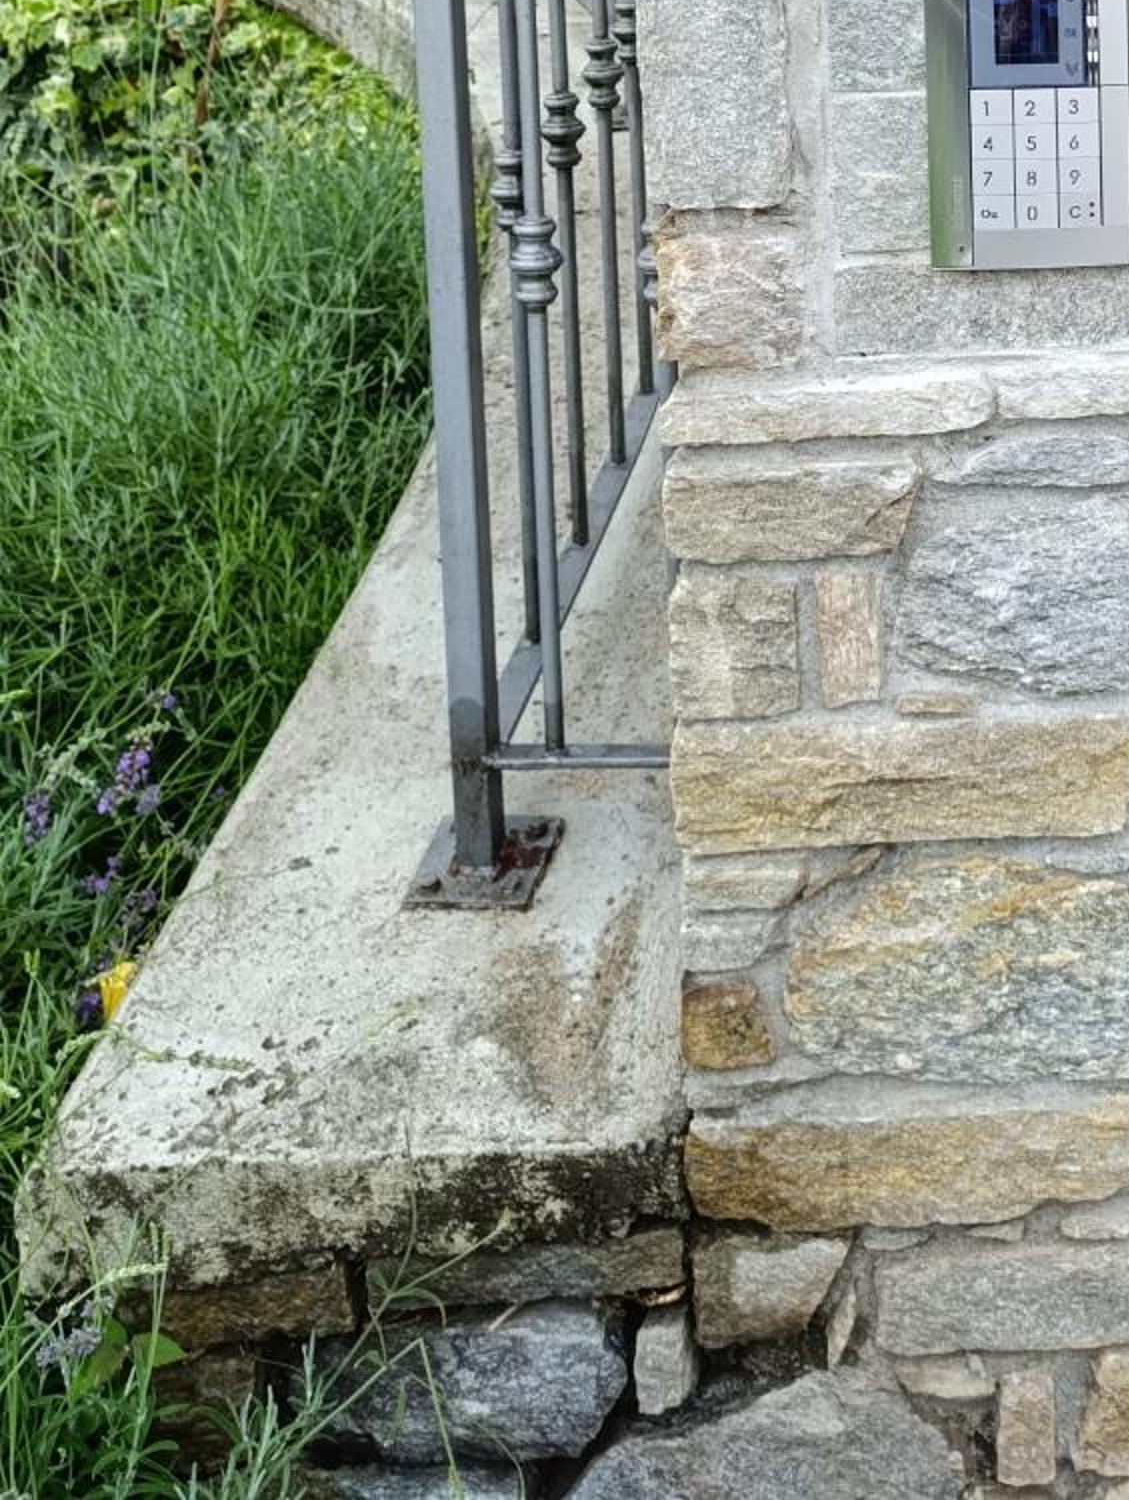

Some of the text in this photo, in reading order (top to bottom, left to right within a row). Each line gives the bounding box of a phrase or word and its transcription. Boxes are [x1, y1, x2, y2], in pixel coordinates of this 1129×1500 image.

[983, 100, 1079, 116] 1 2 3
[983, 135, 1079, 151] 4 5 6
[983, 170, 1080, 186] 7 8 9
